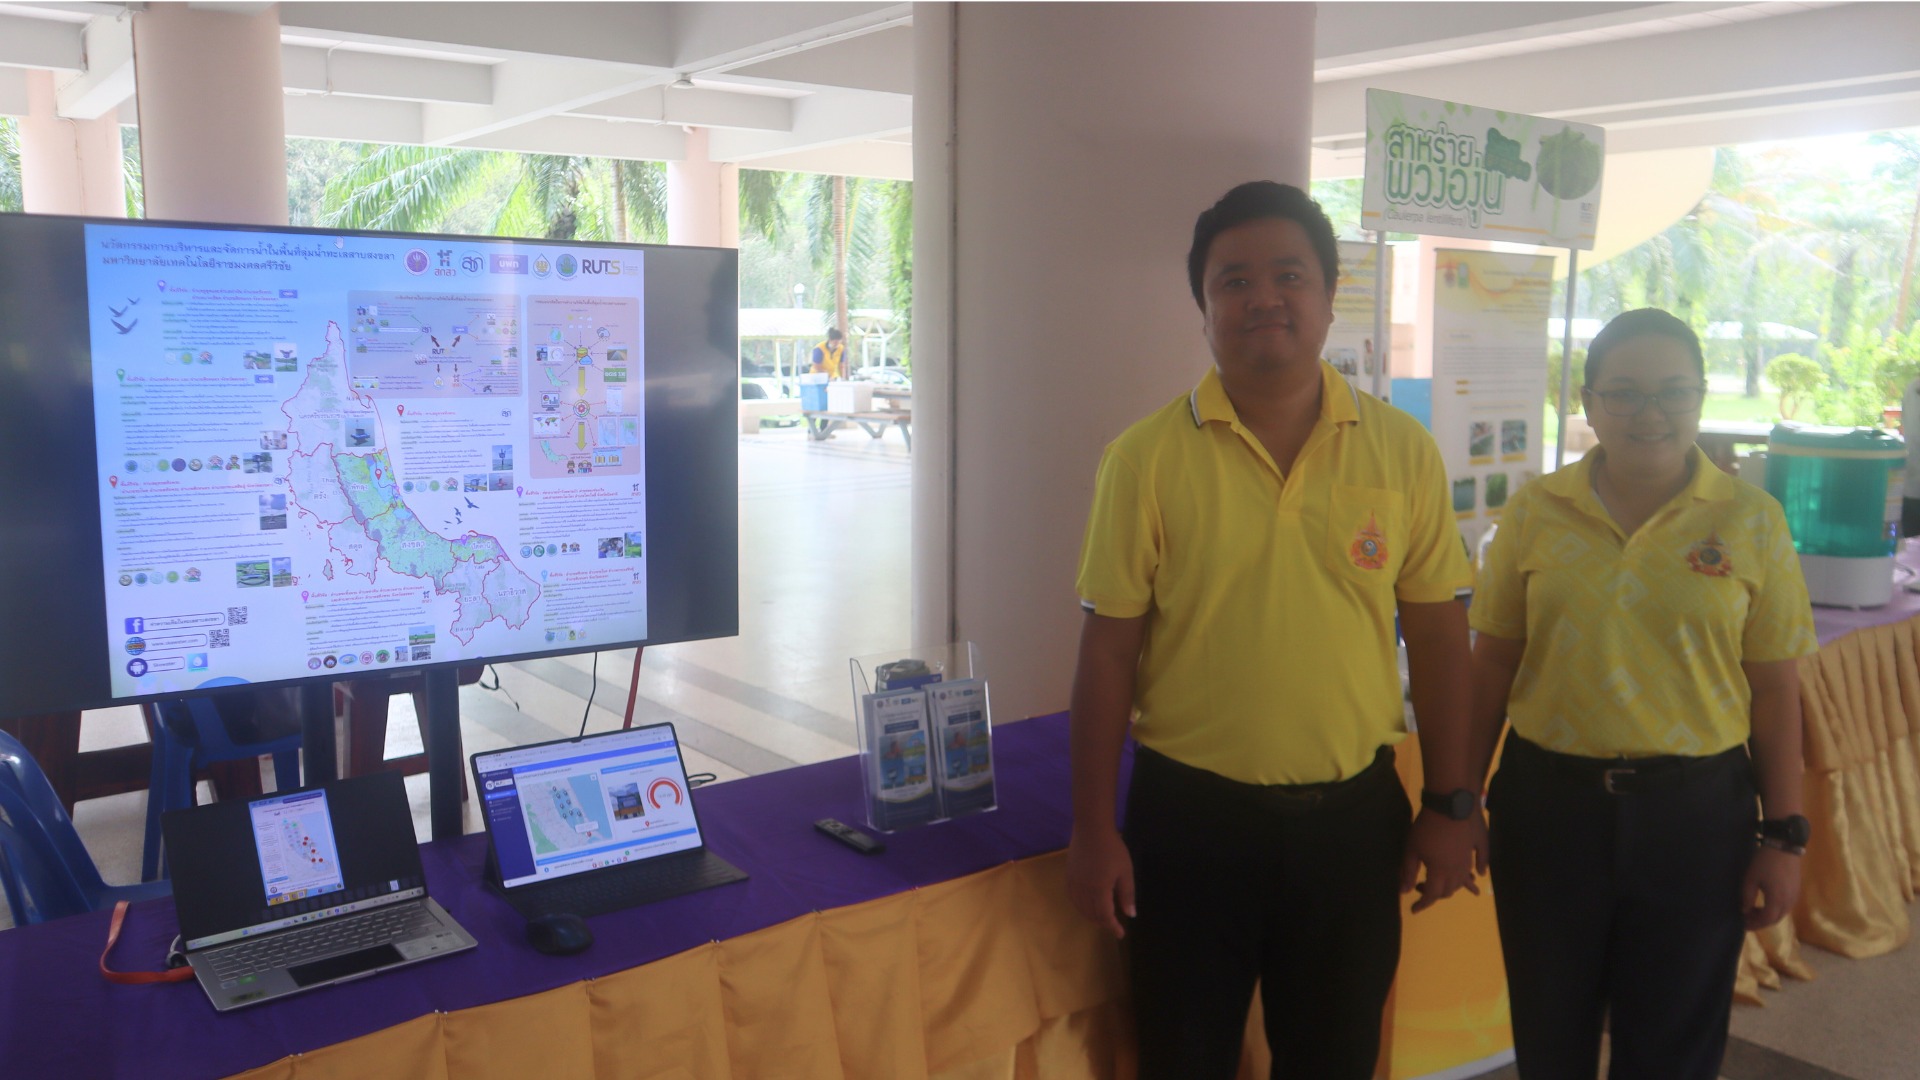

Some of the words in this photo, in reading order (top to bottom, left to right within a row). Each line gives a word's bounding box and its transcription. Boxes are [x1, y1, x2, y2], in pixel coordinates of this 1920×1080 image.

[1388, 124, 1474, 168] สาหร่าย
[1387, 154, 1504, 226] พวงองุ่น
[101, 239, 395, 261] นวัตกรรมการบริหารและจัดการน้ำในพื้นที่ลุ่มน้ำทะเลสาบสงขลา
[102, 254, 292, 271] มหาวิทยาลัยเทคโนโลยีราชมงคลศรีวิชัย
[582, 259, 621, 275] RUTS
[314, 490, 327, 500] ตรัง
[402, 541, 425, 549] สงขลา
[498, 587, 527, 597] นราธิวาส
